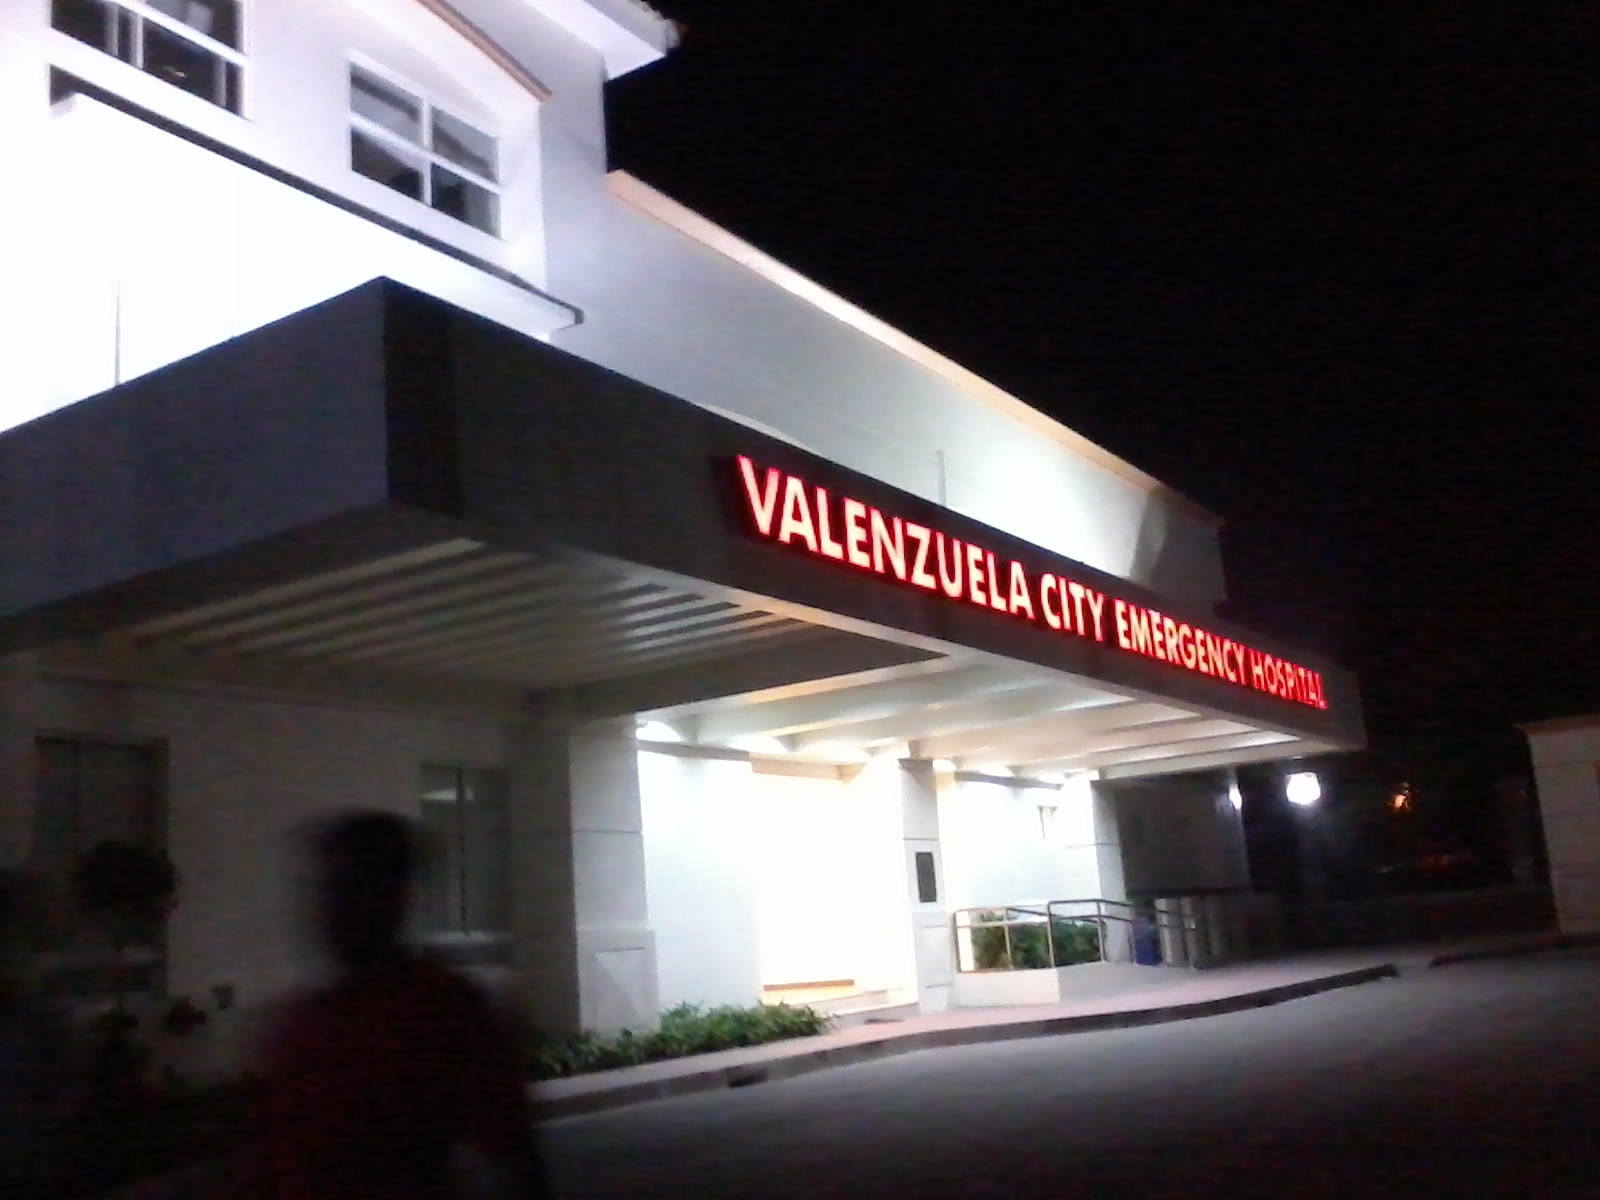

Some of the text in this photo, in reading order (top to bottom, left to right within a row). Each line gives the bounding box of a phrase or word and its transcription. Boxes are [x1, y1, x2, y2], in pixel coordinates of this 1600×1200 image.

[738, 455, 1327, 709] VALENZUELA CITY EMERGENCY HOSPITAL
